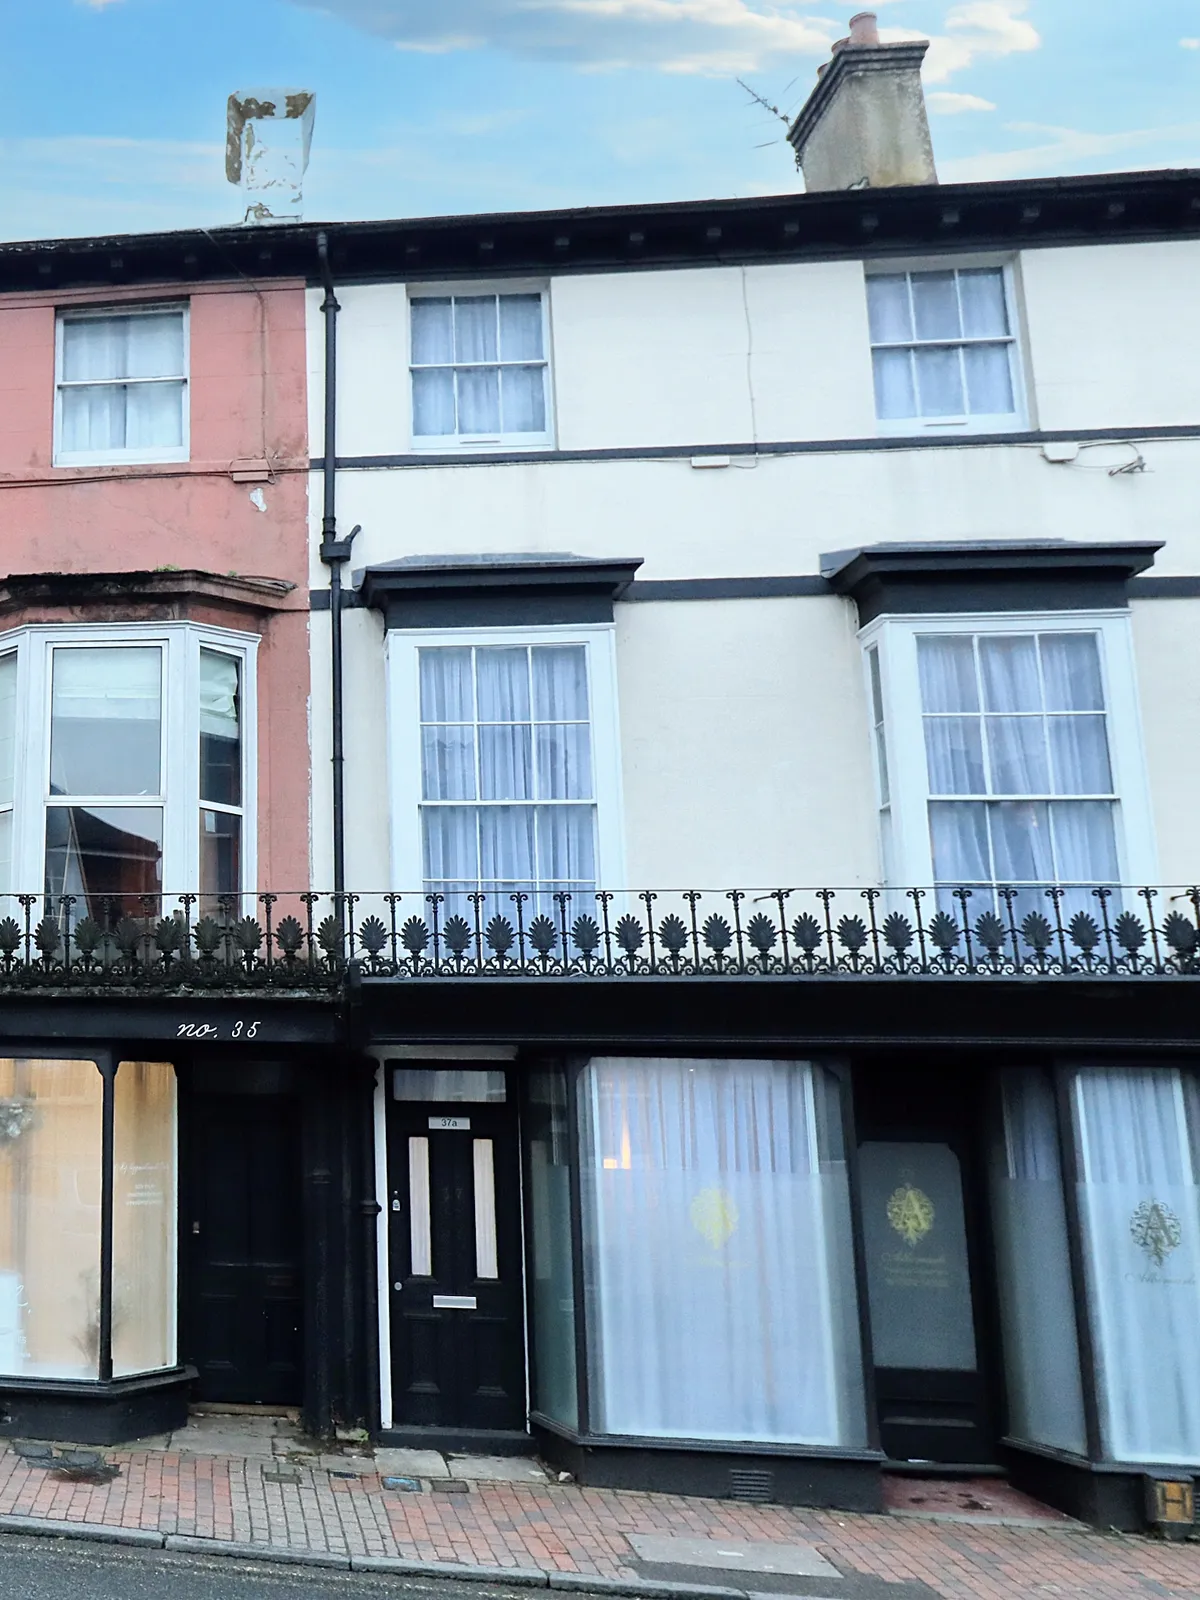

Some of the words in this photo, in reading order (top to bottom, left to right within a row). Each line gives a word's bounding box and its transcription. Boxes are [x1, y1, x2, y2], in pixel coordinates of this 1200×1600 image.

[176, 1023, 218, 1039] no.
[231, 1020, 261, 1038] 35
[441, 1118, 458, 1127] 37a
[1161, 1486, 1186, 1520] H
